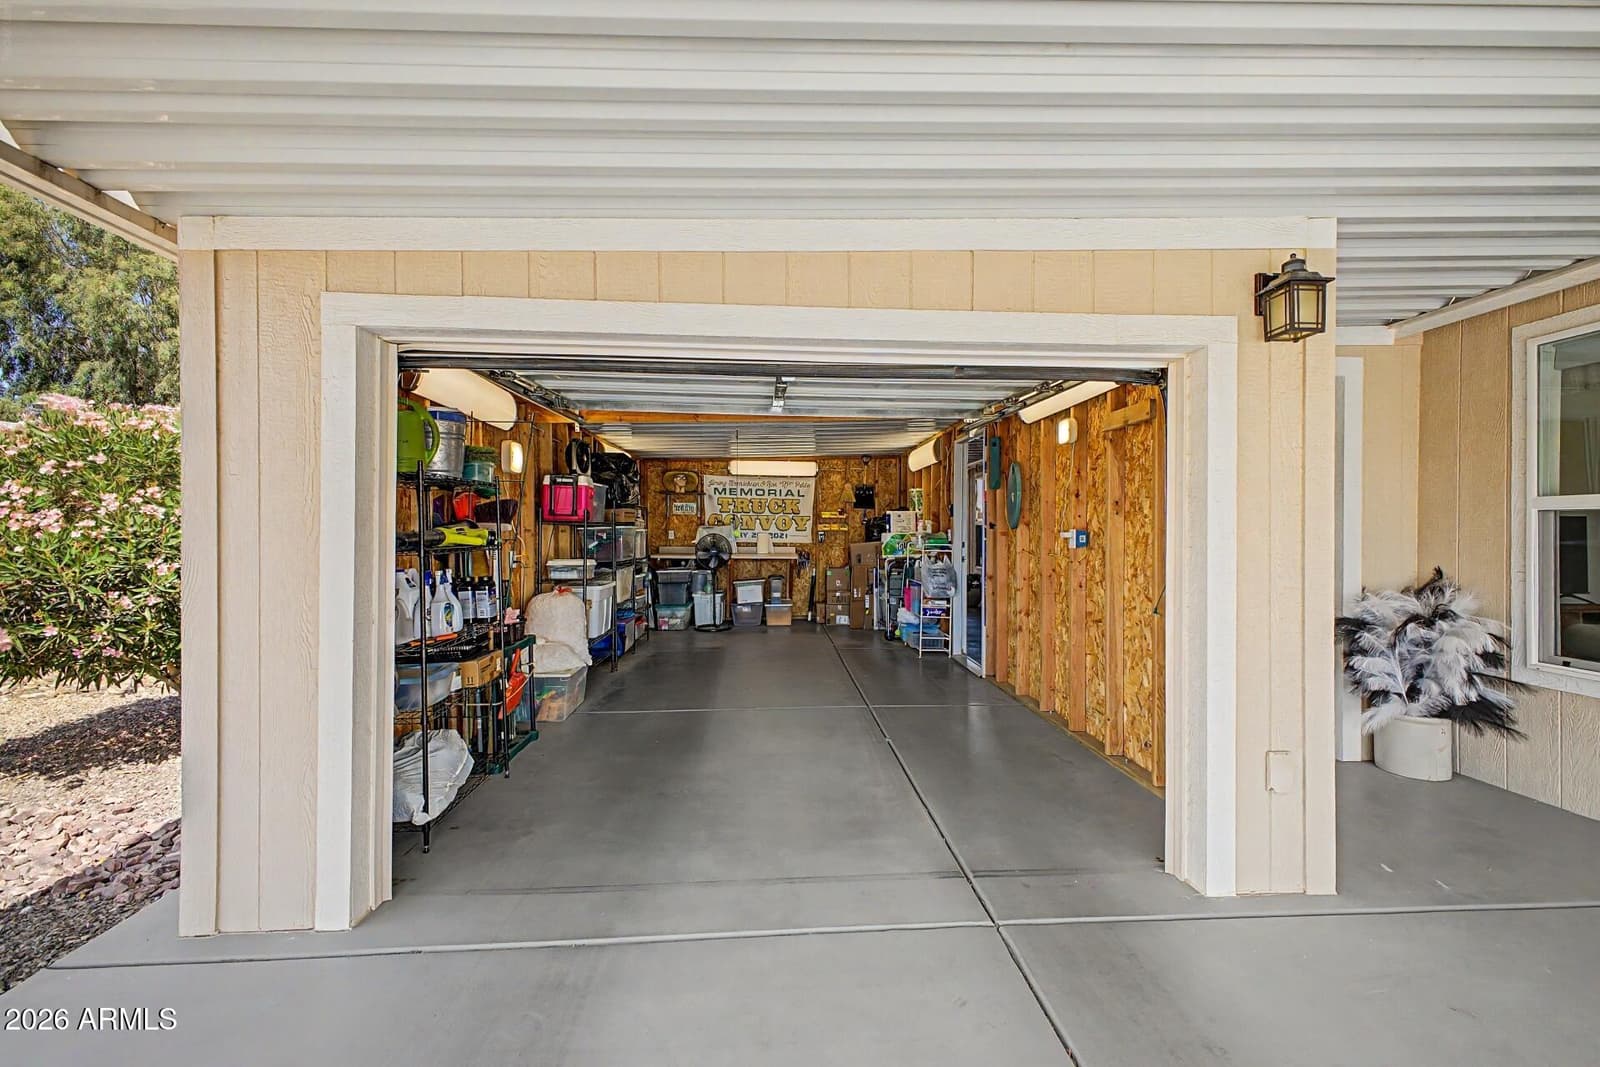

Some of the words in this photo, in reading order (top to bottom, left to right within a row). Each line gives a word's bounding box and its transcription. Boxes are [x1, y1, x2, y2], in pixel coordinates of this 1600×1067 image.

[713, 487, 805, 497] MEMORIAL
[717, 497, 801, 514] TRUCK
[708, 513, 811, 531] CONVOY
